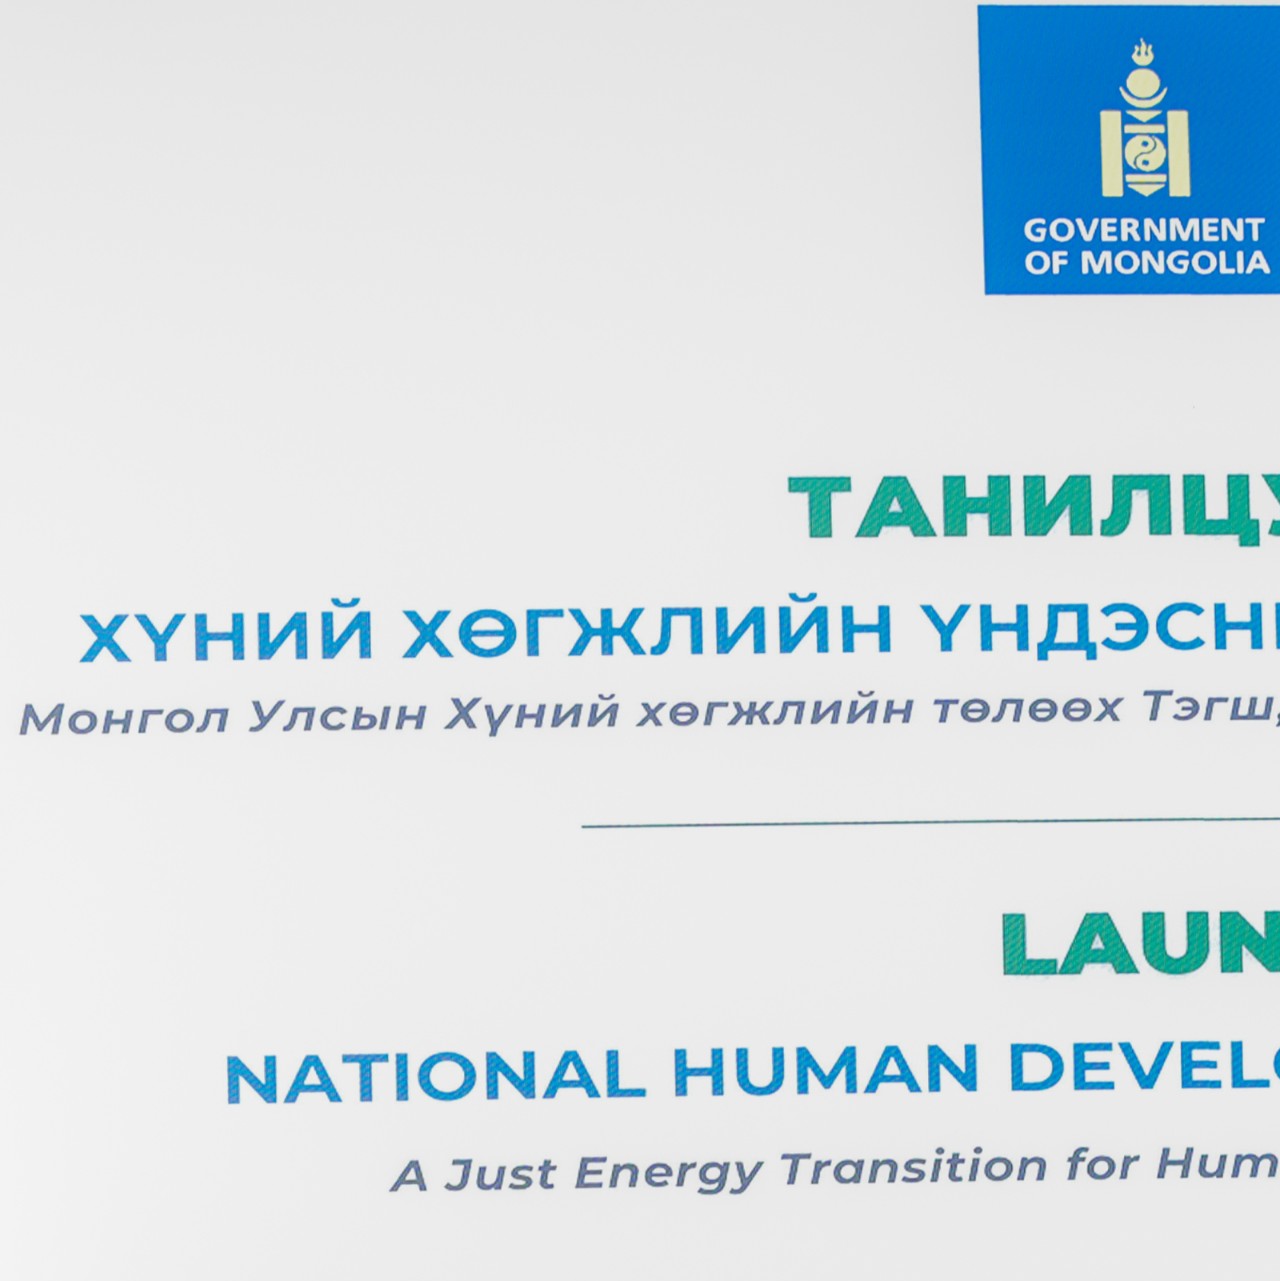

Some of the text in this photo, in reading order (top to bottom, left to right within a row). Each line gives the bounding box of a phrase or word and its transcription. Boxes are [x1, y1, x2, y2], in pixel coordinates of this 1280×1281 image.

[1023, 217, 1268, 244] GOVERNMENT
[1024, 250, 1272, 277] OF MONGOLIA
[80, 597, 373, 665] ХҮНИЙ
[403, 592, 893, 660] ХӨГЖЛИЙН
[18, 702, 231, 738] Монгол
[249, 700, 428, 734] Улсын
[444, 694, 621, 739] Хүний
[637, 691, 915, 730] хөгжлийн
[934, 698, 1125, 725] төлөөх
[227, 1049, 649, 1106] NATIONAL
[674, 1044, 979, 1099] HUMAN
[390, 1160, 429, 1194] A
[445, 1158, 559, 1193] Just
[575, 1155, 766, 1197] Energy
[781, 1147, 1048, 1186] Transition
[1067, 1147, 1142, 1182] for
